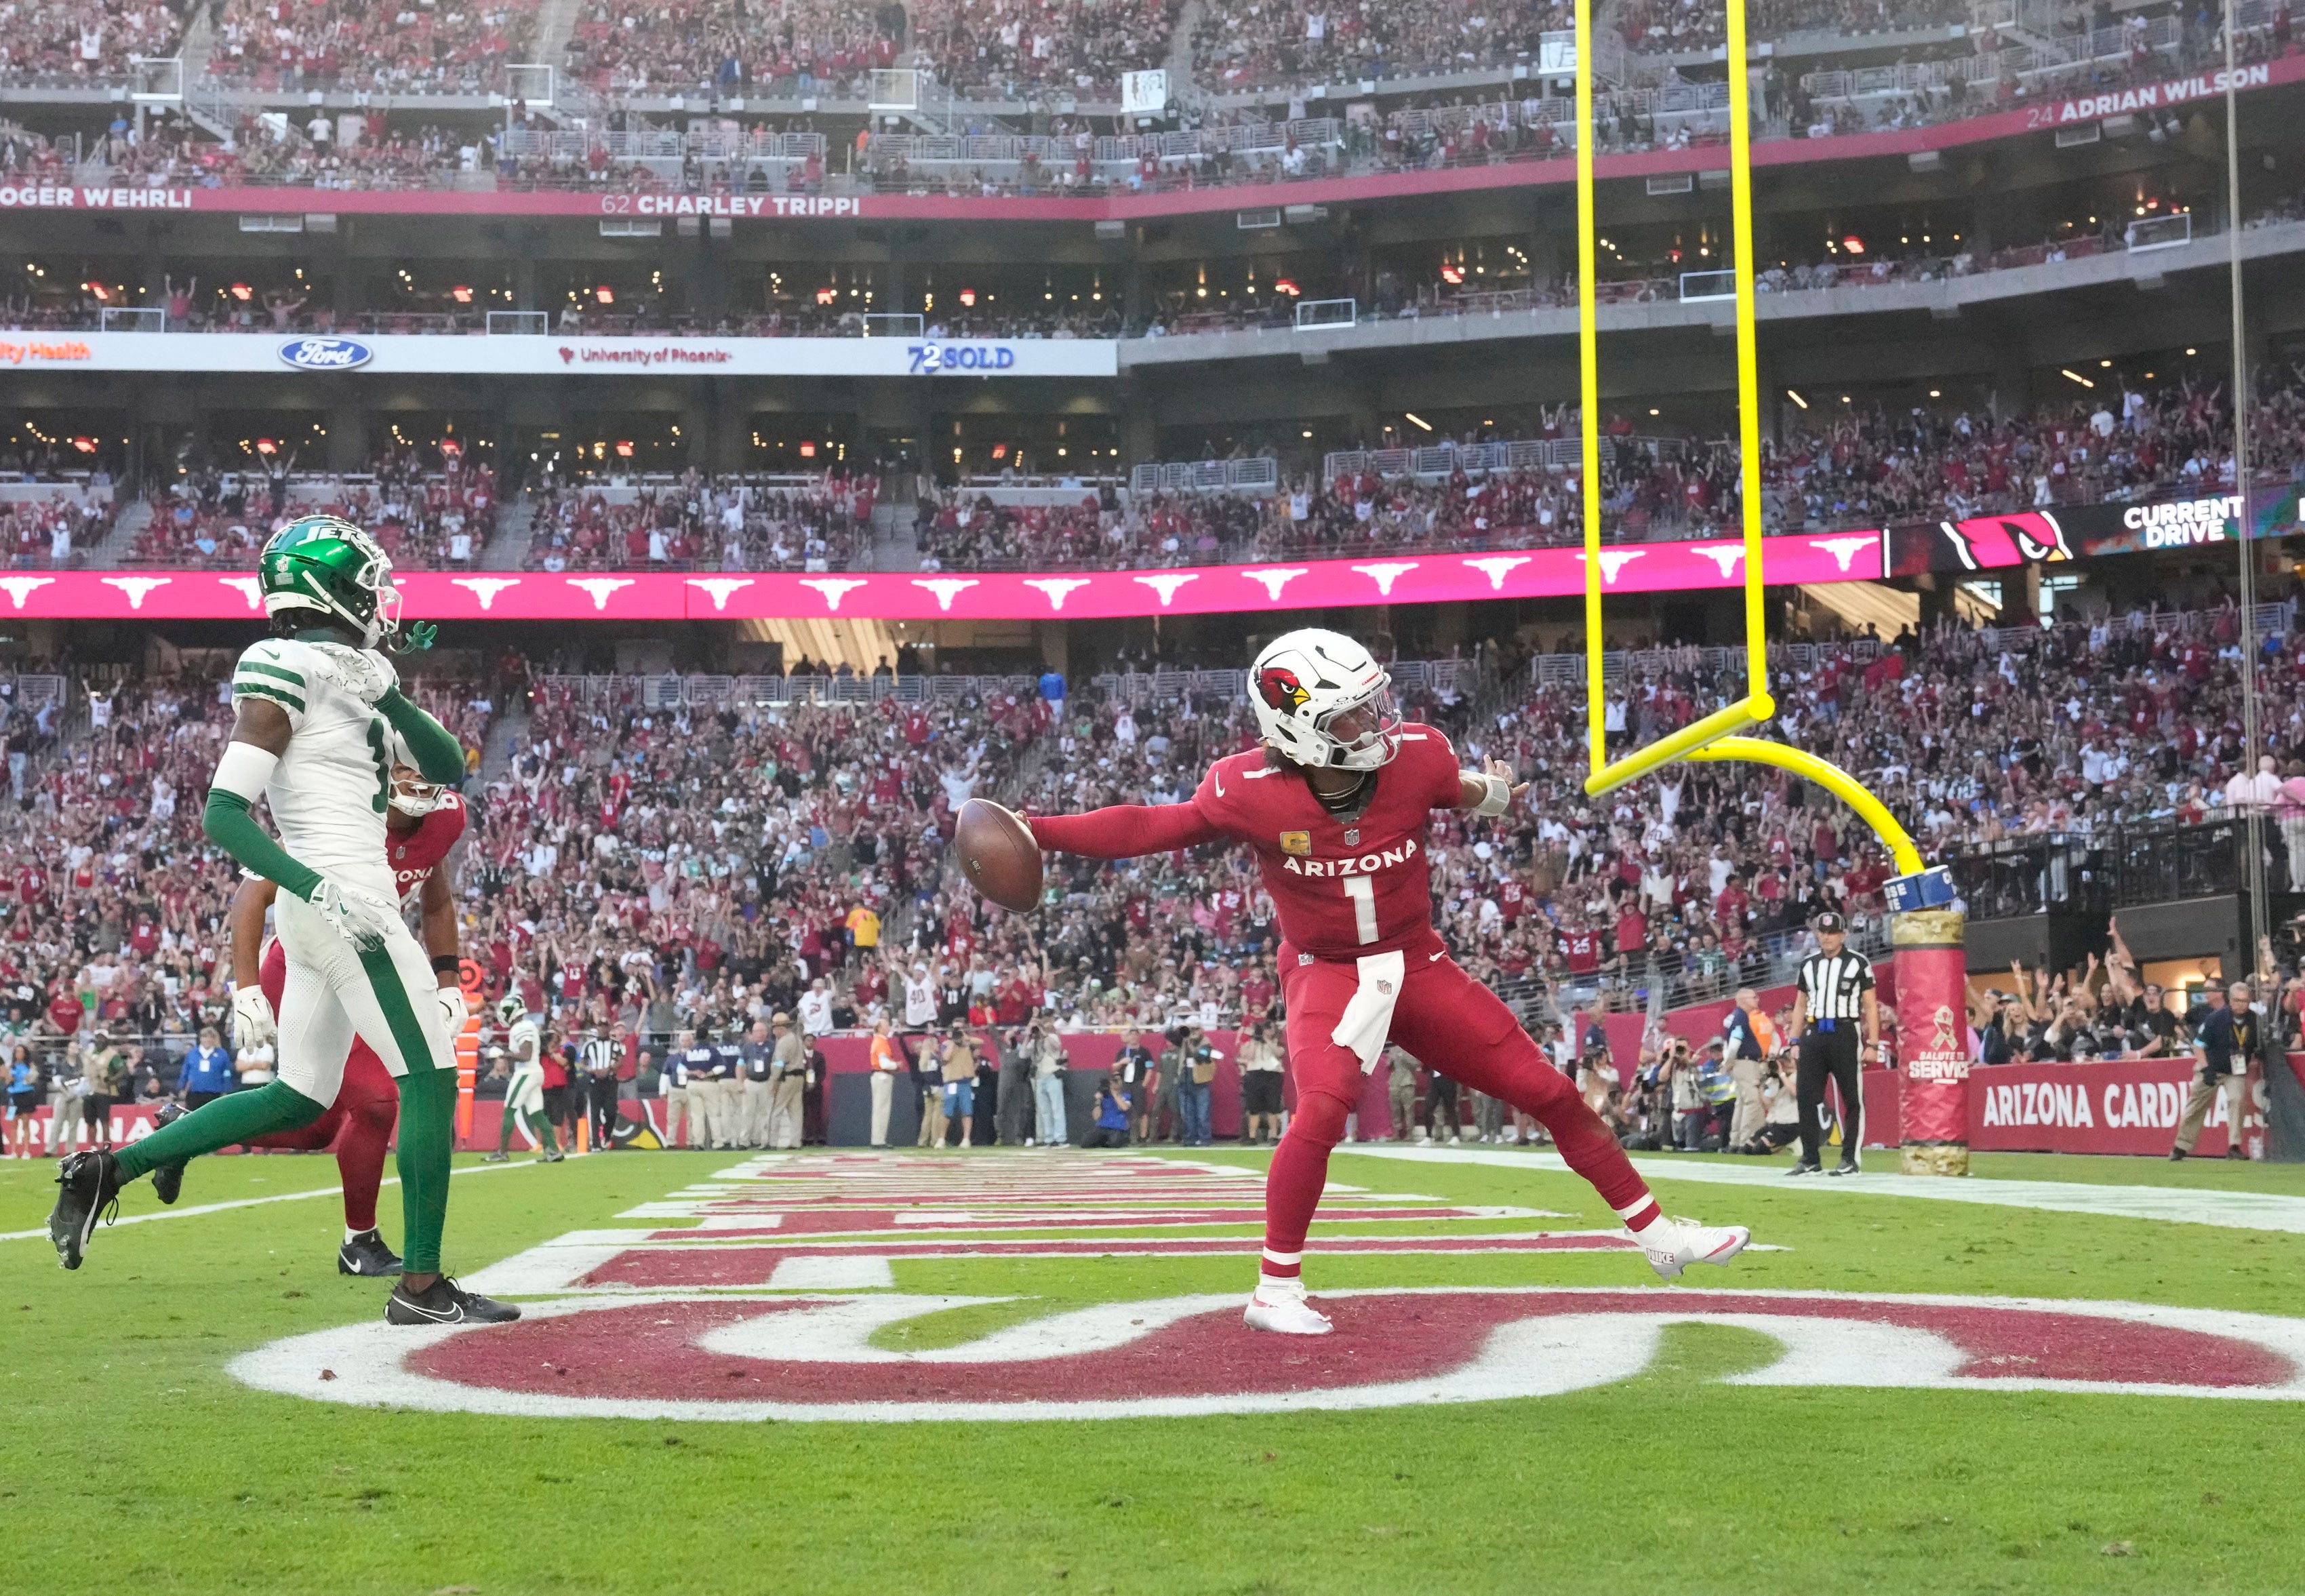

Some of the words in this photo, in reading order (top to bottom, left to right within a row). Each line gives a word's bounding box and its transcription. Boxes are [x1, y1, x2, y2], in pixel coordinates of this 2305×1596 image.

[2027, 106, 2053, 128] 24
[2060, 86, 2157, 121] ADRIAN
[2164, 64, 2269, 101] WILSON
[83, 188, 191, 208] WEHRLI
[601, 195, 630, 214] 62
[637, 195, 764, 215] CHARLEY
[772, 197, 860, 215] TRIPPI
[29, 340, 91, 360] Health
[295, 340, 355, 364] Ford
[581, 347, 651, 366] University
[654, 346, 668, 363] of
[672, 347, 726, 363] Phoenix
[2124, 496, 2244, 529] CURRENT
[296, 525, 371, 546] JETS
[2146, 519, 2224, 547] DRIVE
[1283, 839, 1417, 877] ARIZONA
[1343, 875, 1379, 945] 1
[1919, 1052, 1955, 1060] SALUTE
[1983, 1083, 2093, 1128] ARIZONA
[2104, 1079, 2270, 1128] CARDIAS
[1646, 1248, 1675, 1264] NIKE
